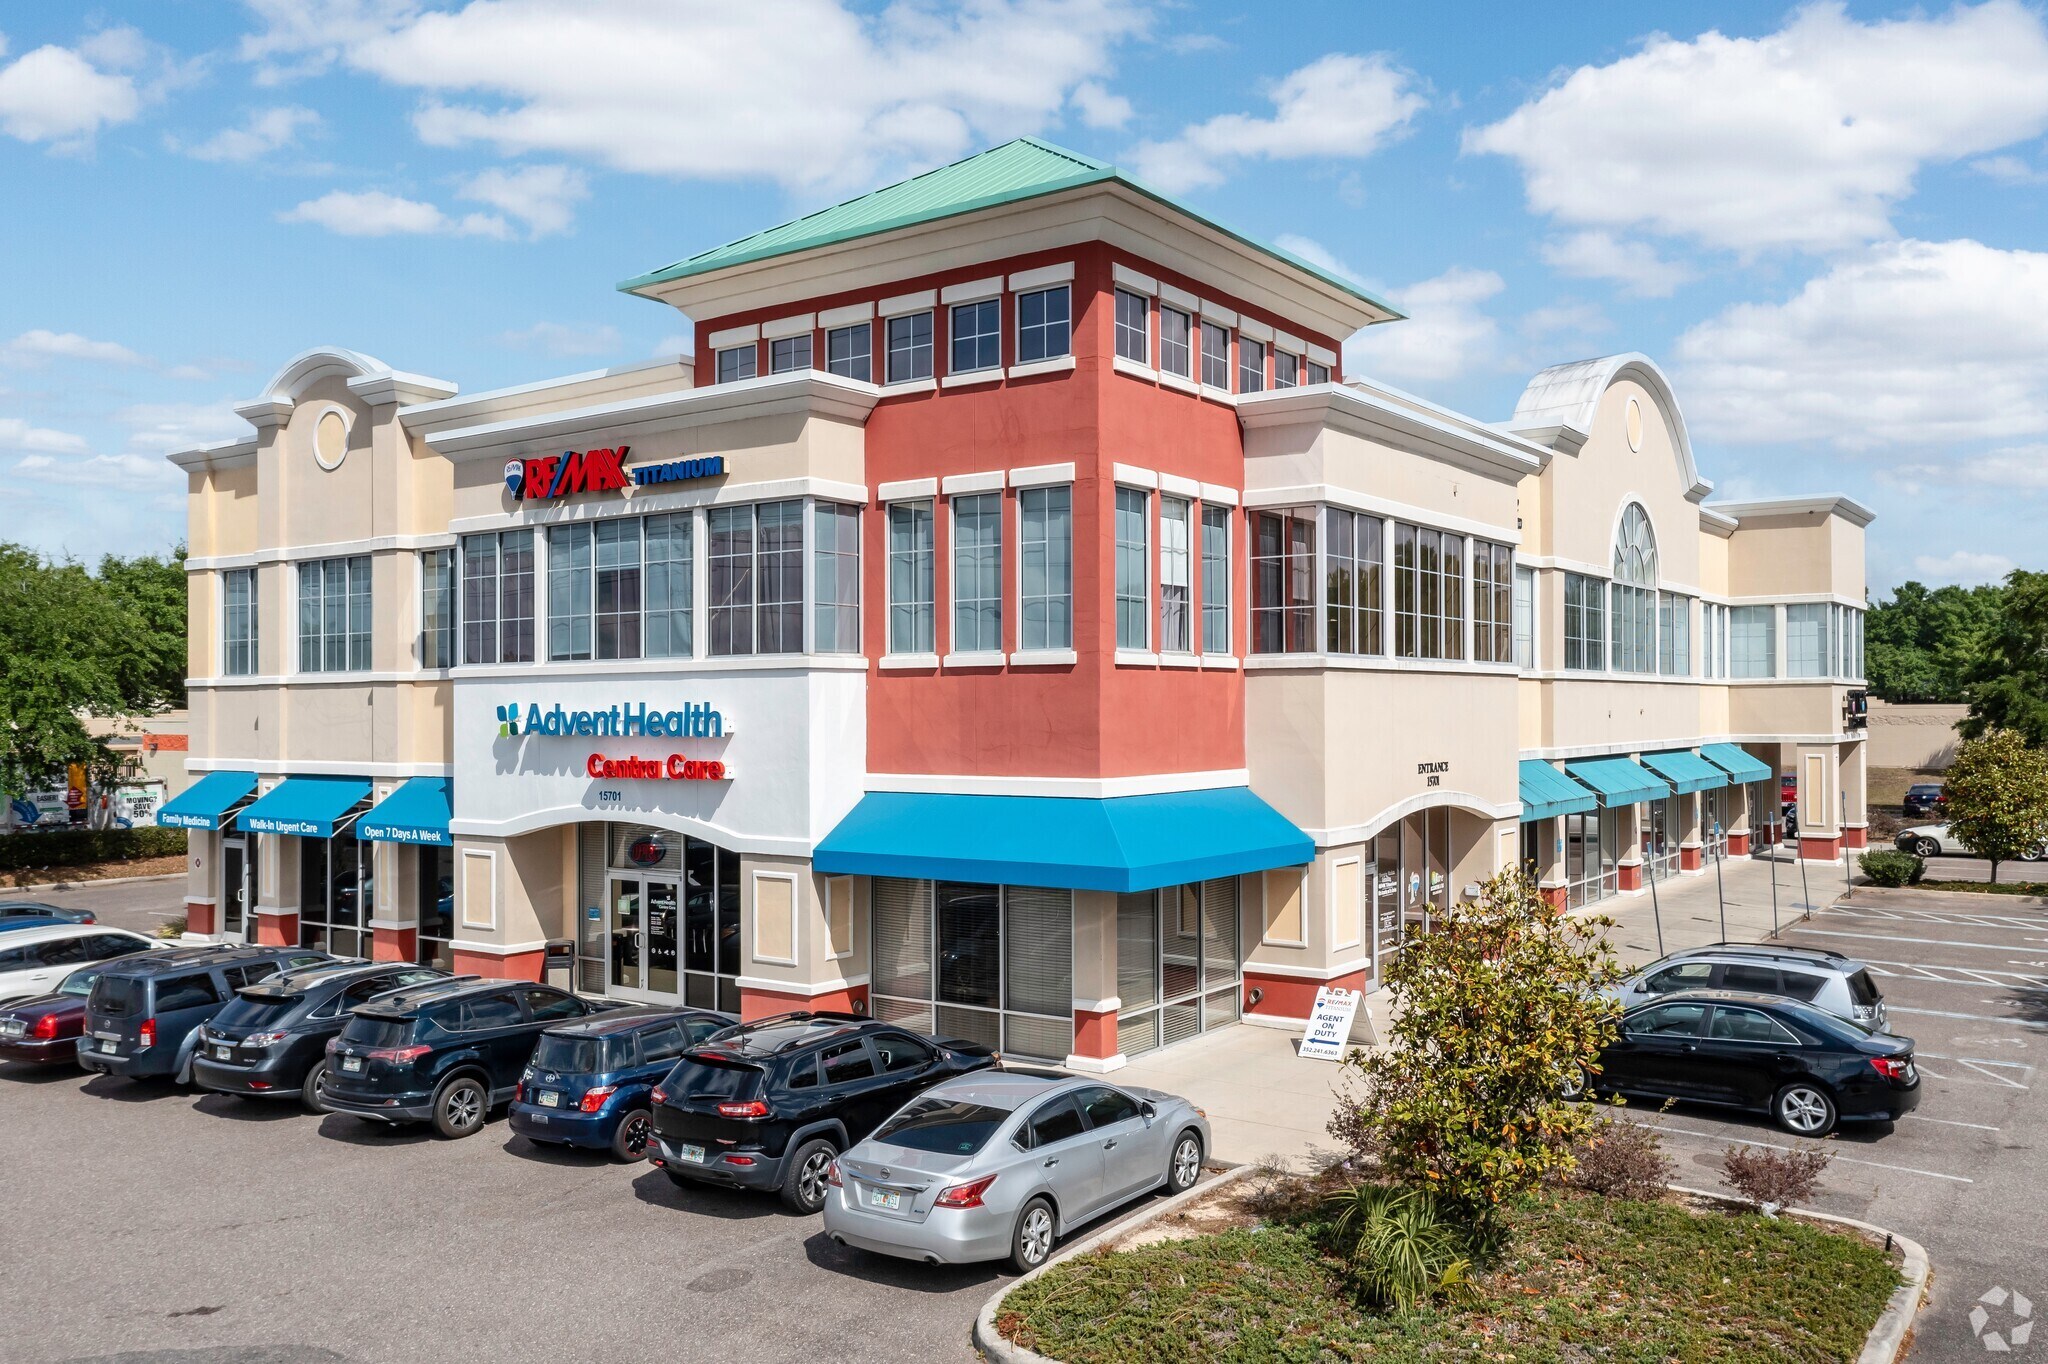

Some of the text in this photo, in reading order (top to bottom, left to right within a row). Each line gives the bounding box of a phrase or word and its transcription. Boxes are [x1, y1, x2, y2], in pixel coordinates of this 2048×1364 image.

[525, 446, 724, 499] RE/MAX TITANIUM
[523, 702, 723, 737] AdventHealth
[587, 753, 726, 781] Centra Care
[1418, 762, 1449, 774] ENTRANCE
[36, 794, 59, 803] EASIER!
[126, 796, 157, 804] MOVING?
[598, 791, 622, 802] 15701
[133, 803, 151, 811] SAVE
[162, 813, 211, 827] Family Medicine
[250, 818, 318, 834] Walk-In Urgent Care
[365, 826, 441, 842] Open 7 Days A Week
[1327, 999, 1352, 1007] RE/MAX
[1317, 1014, 1344, 1023] AGENT
[1314, 1030, 1337, 1038] DUTY
